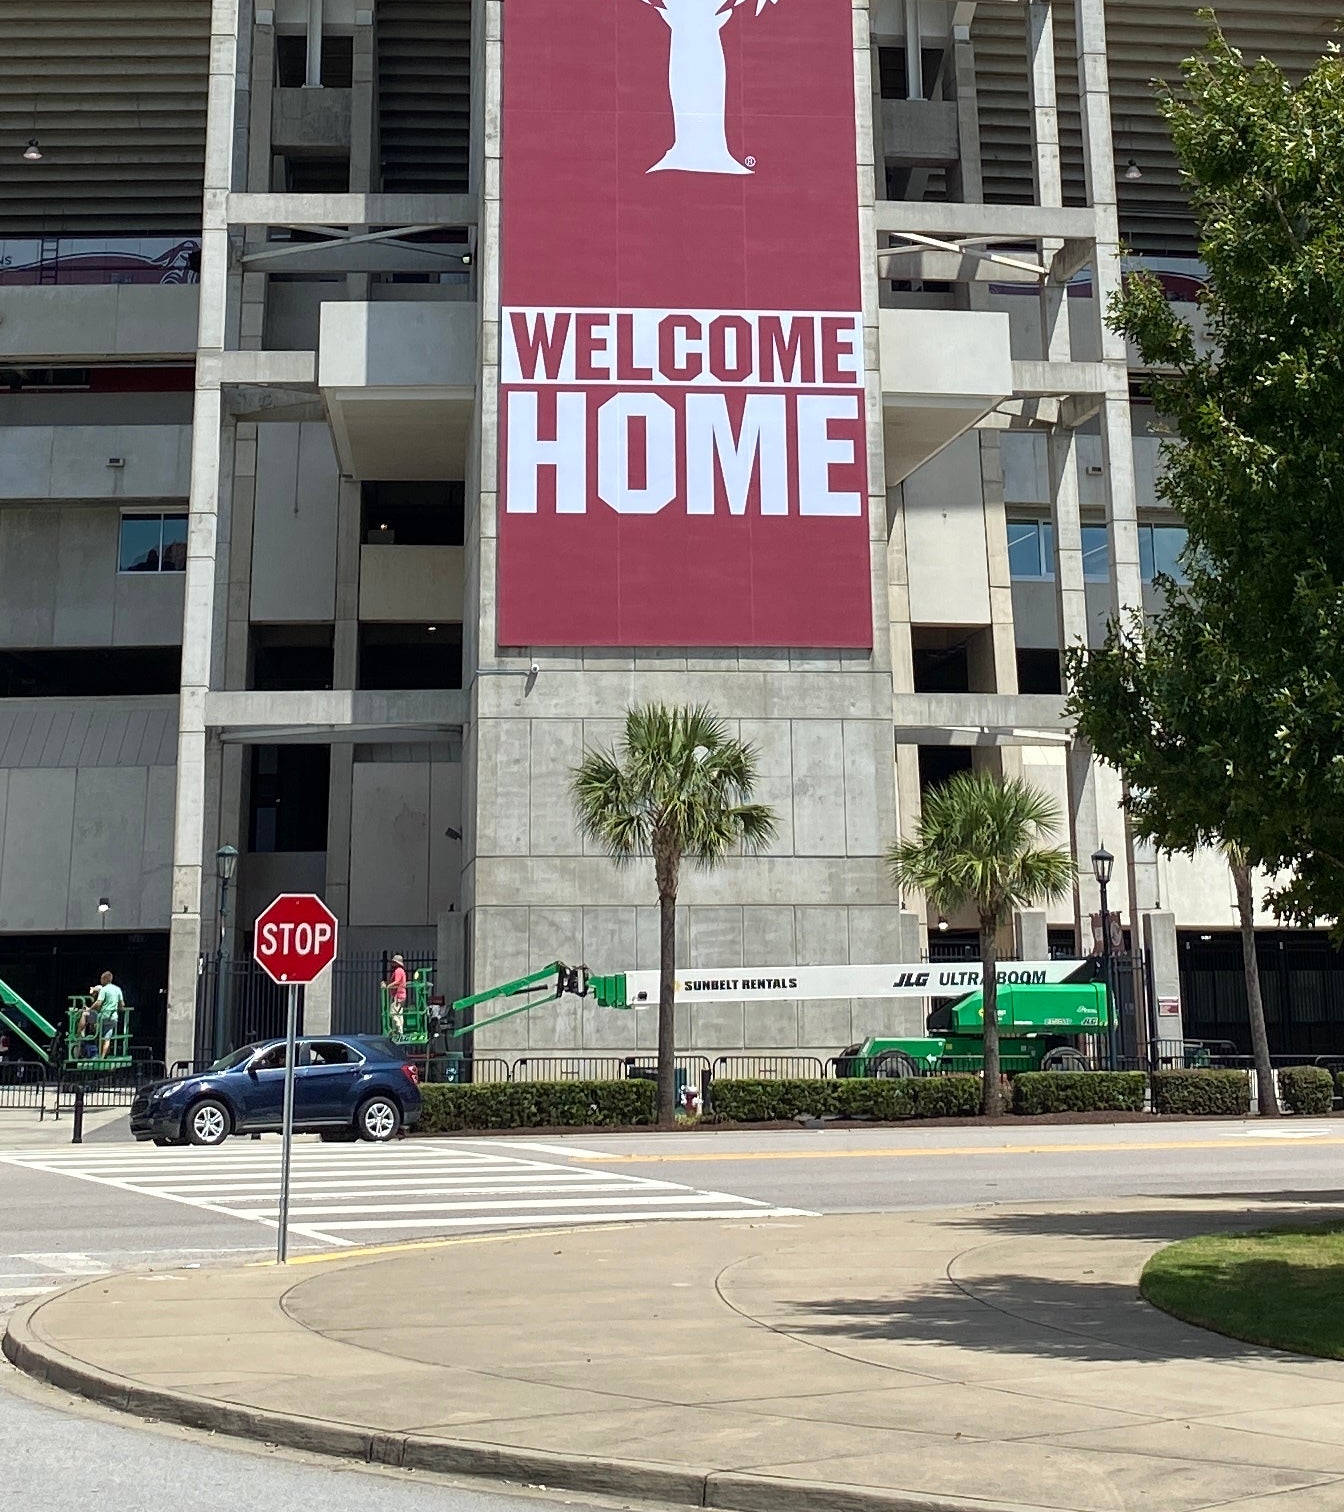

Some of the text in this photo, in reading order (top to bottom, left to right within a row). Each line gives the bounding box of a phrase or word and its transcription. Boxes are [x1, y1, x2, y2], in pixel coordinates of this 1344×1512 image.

[508, 312, 858, 384] WELCOME
[506, 390, 862, 517] HOME
[260, 922, 332, 956] STOP
[684, 978, 798, 992] SUNBELT RENTALS
[892, 970, 1047, 988] JLG ULTR BOOM
